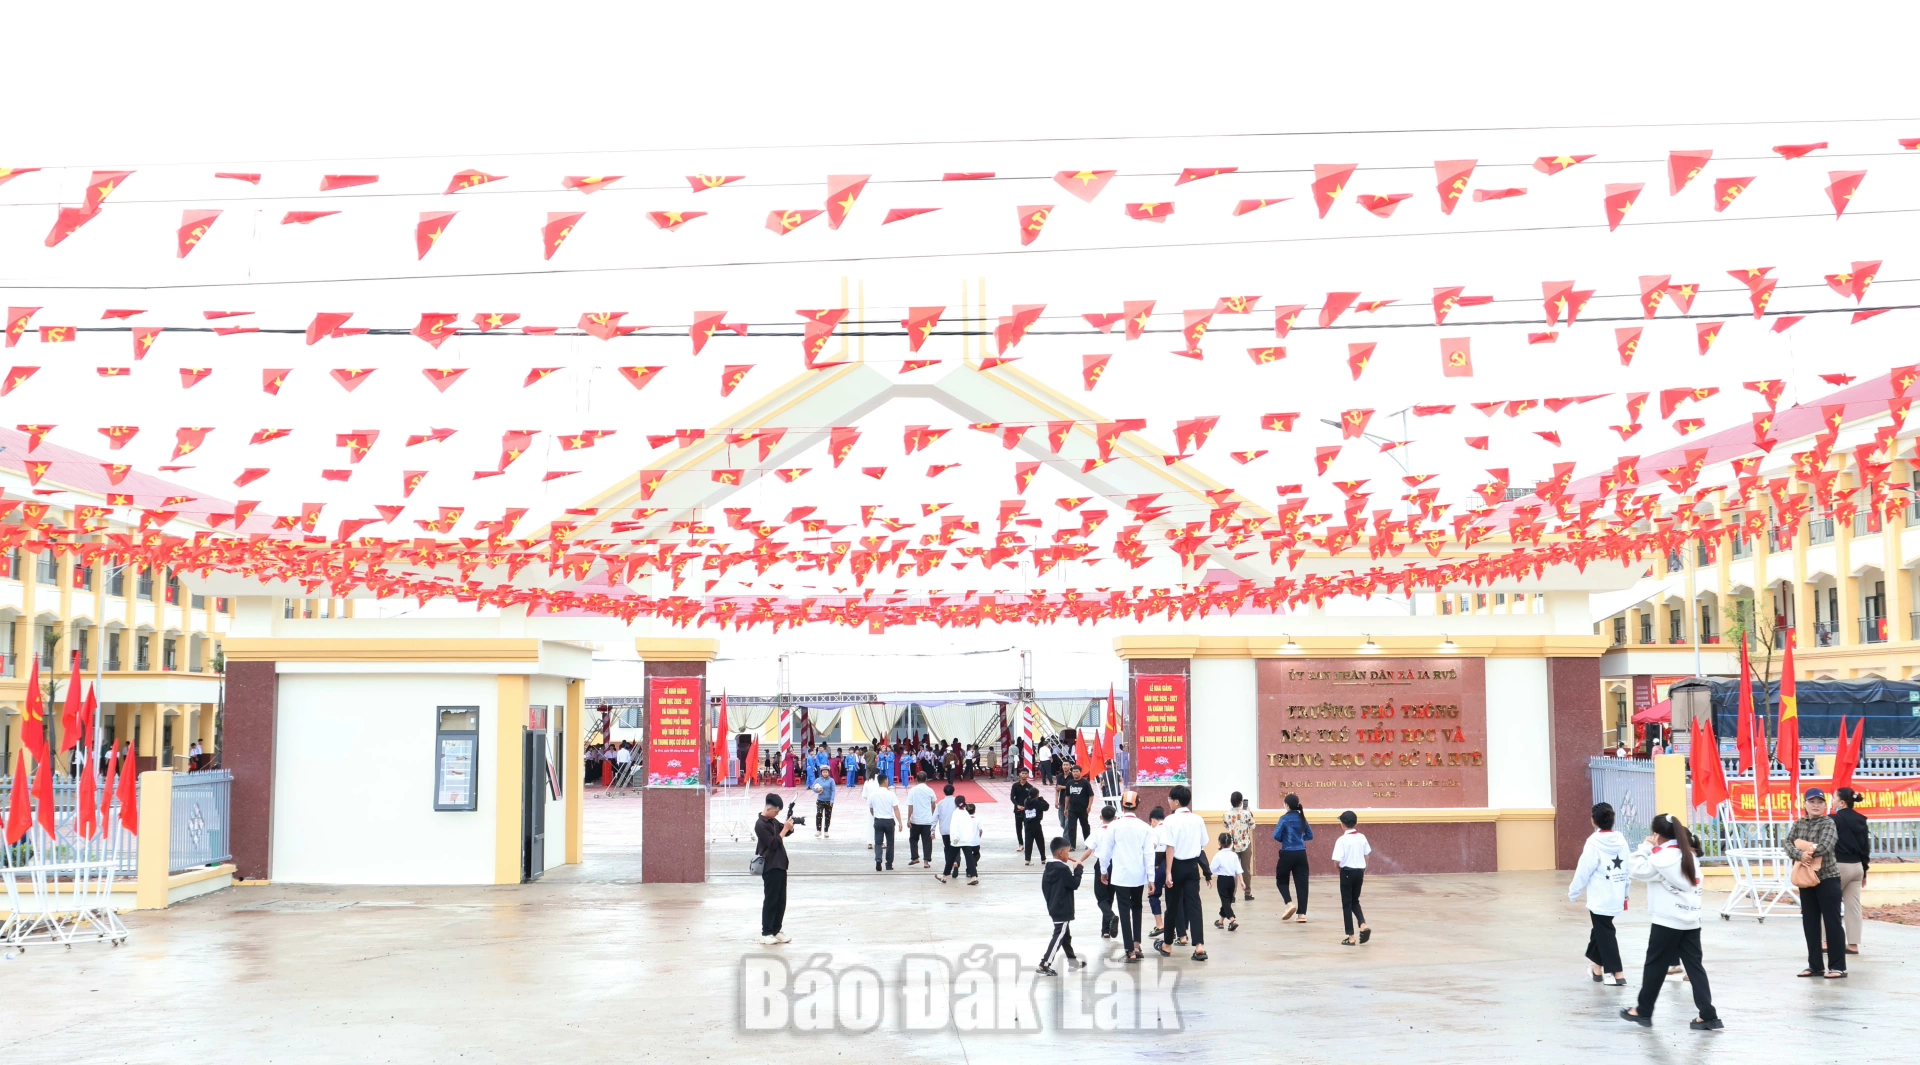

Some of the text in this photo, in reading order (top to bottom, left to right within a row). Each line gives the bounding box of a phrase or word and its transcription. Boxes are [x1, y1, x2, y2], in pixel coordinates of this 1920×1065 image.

[1307, 670, 1330, 680] BAN
[1333, 669, 1366, 680] NHÂN
[1370, 669, 1394, 680] DÂN
[1398, 669, 1414, 680] XÃ
[1418, 670, 1430, 680] IA
[1433, 669, 1456, 680] RVÊ
[1287, 698, 1460, 719] TRƯỜNG PHỔ THÔNG
[1281, 722, 1465, 746] NỘI TRÚ TIỂU HỌC VÀ
[1267, 749, 1483, 769] TRUNG HỌC CƠ SỞ IA RVÊ
[1878, 788, 1895, 811] HỘI
[1896, 787, 1920, 808] TOÀN
